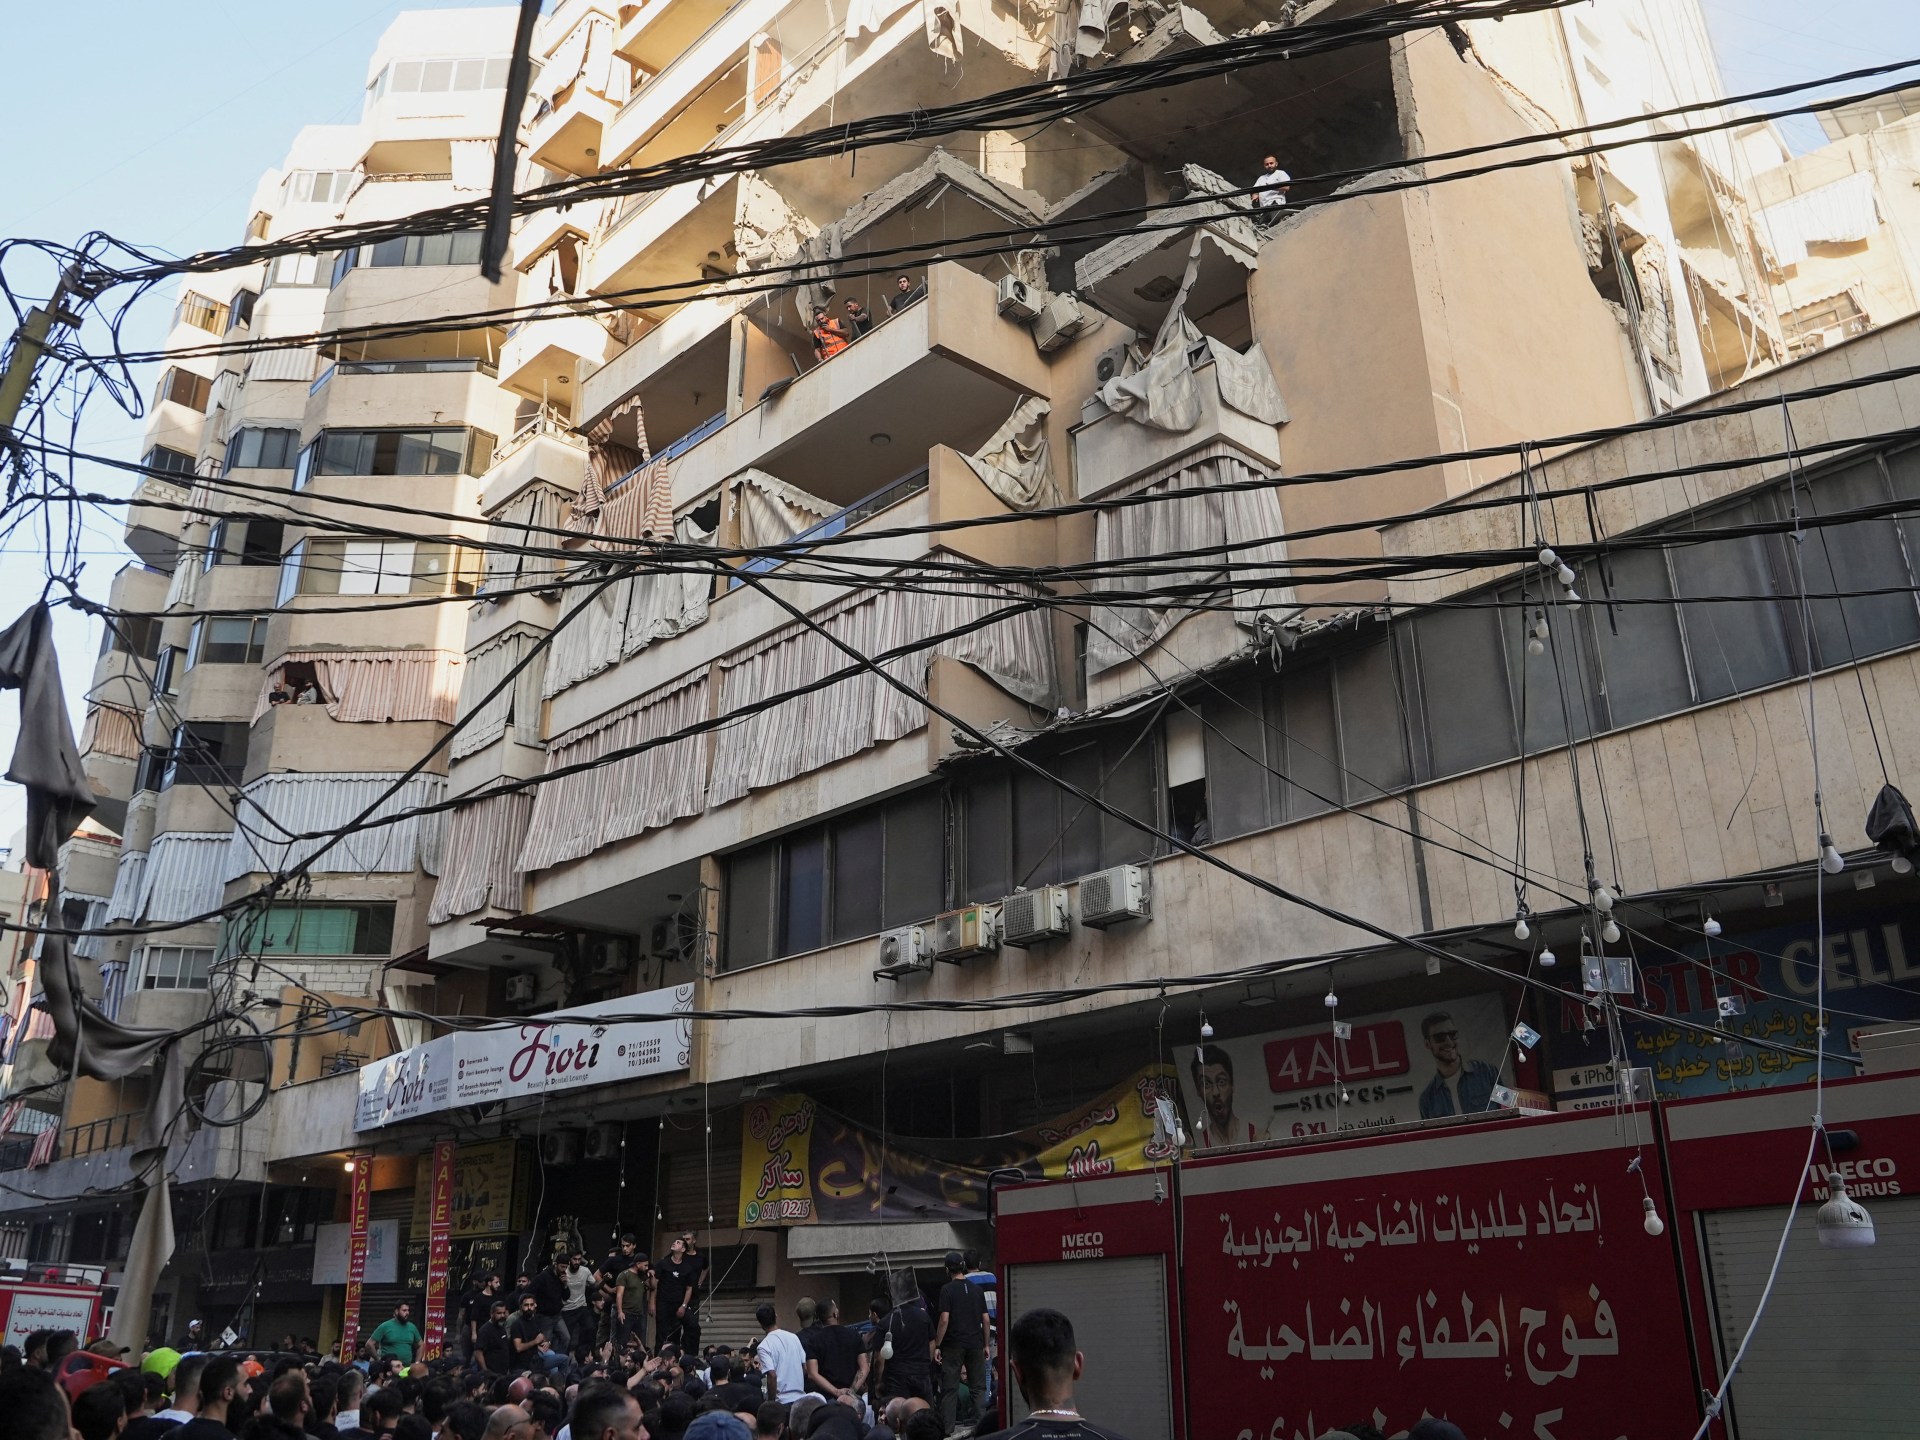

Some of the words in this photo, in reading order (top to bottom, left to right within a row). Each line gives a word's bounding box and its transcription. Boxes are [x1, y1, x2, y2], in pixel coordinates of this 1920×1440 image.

[1636, 1028, 1681, 1055] خلوية
[1743, 1009, 1797, 1039] وشراء
[509, 1023, 600, 1082] Fiori
[1278, 1029, 1400, 1083] 4ALL
[1656, 1056, 1711, 1083] خطوط
[527, 1078, 543, 1089] Beauty
[551, 1076, 569, 1085] Dental
[569, 1073, 589, 1083] Lounge
[355, 1159, 369, 1230] SALE
[435, 1145, 451, 1221] SALE
[1809, 1157, 1896, 1183] IVECO
[1813, 1181, 1901, 1201] MGIRUS
[1062, 1231, 1104, 1248] IVECO
[1219, 1200, 1319, 1270] الجنوبية
[1324, 1194, 1426, 1262] الضاحية
[1433, 1189, 1526, 1256] بلديات
[1062, 1247, 1104, 1260] MAGIRUS
[1223, 1295, 1387, 1381] الضاحية
[1397, 1289, 1512, 1382] إطفاء
[1518, 1283, 1619, 1387] فوج
